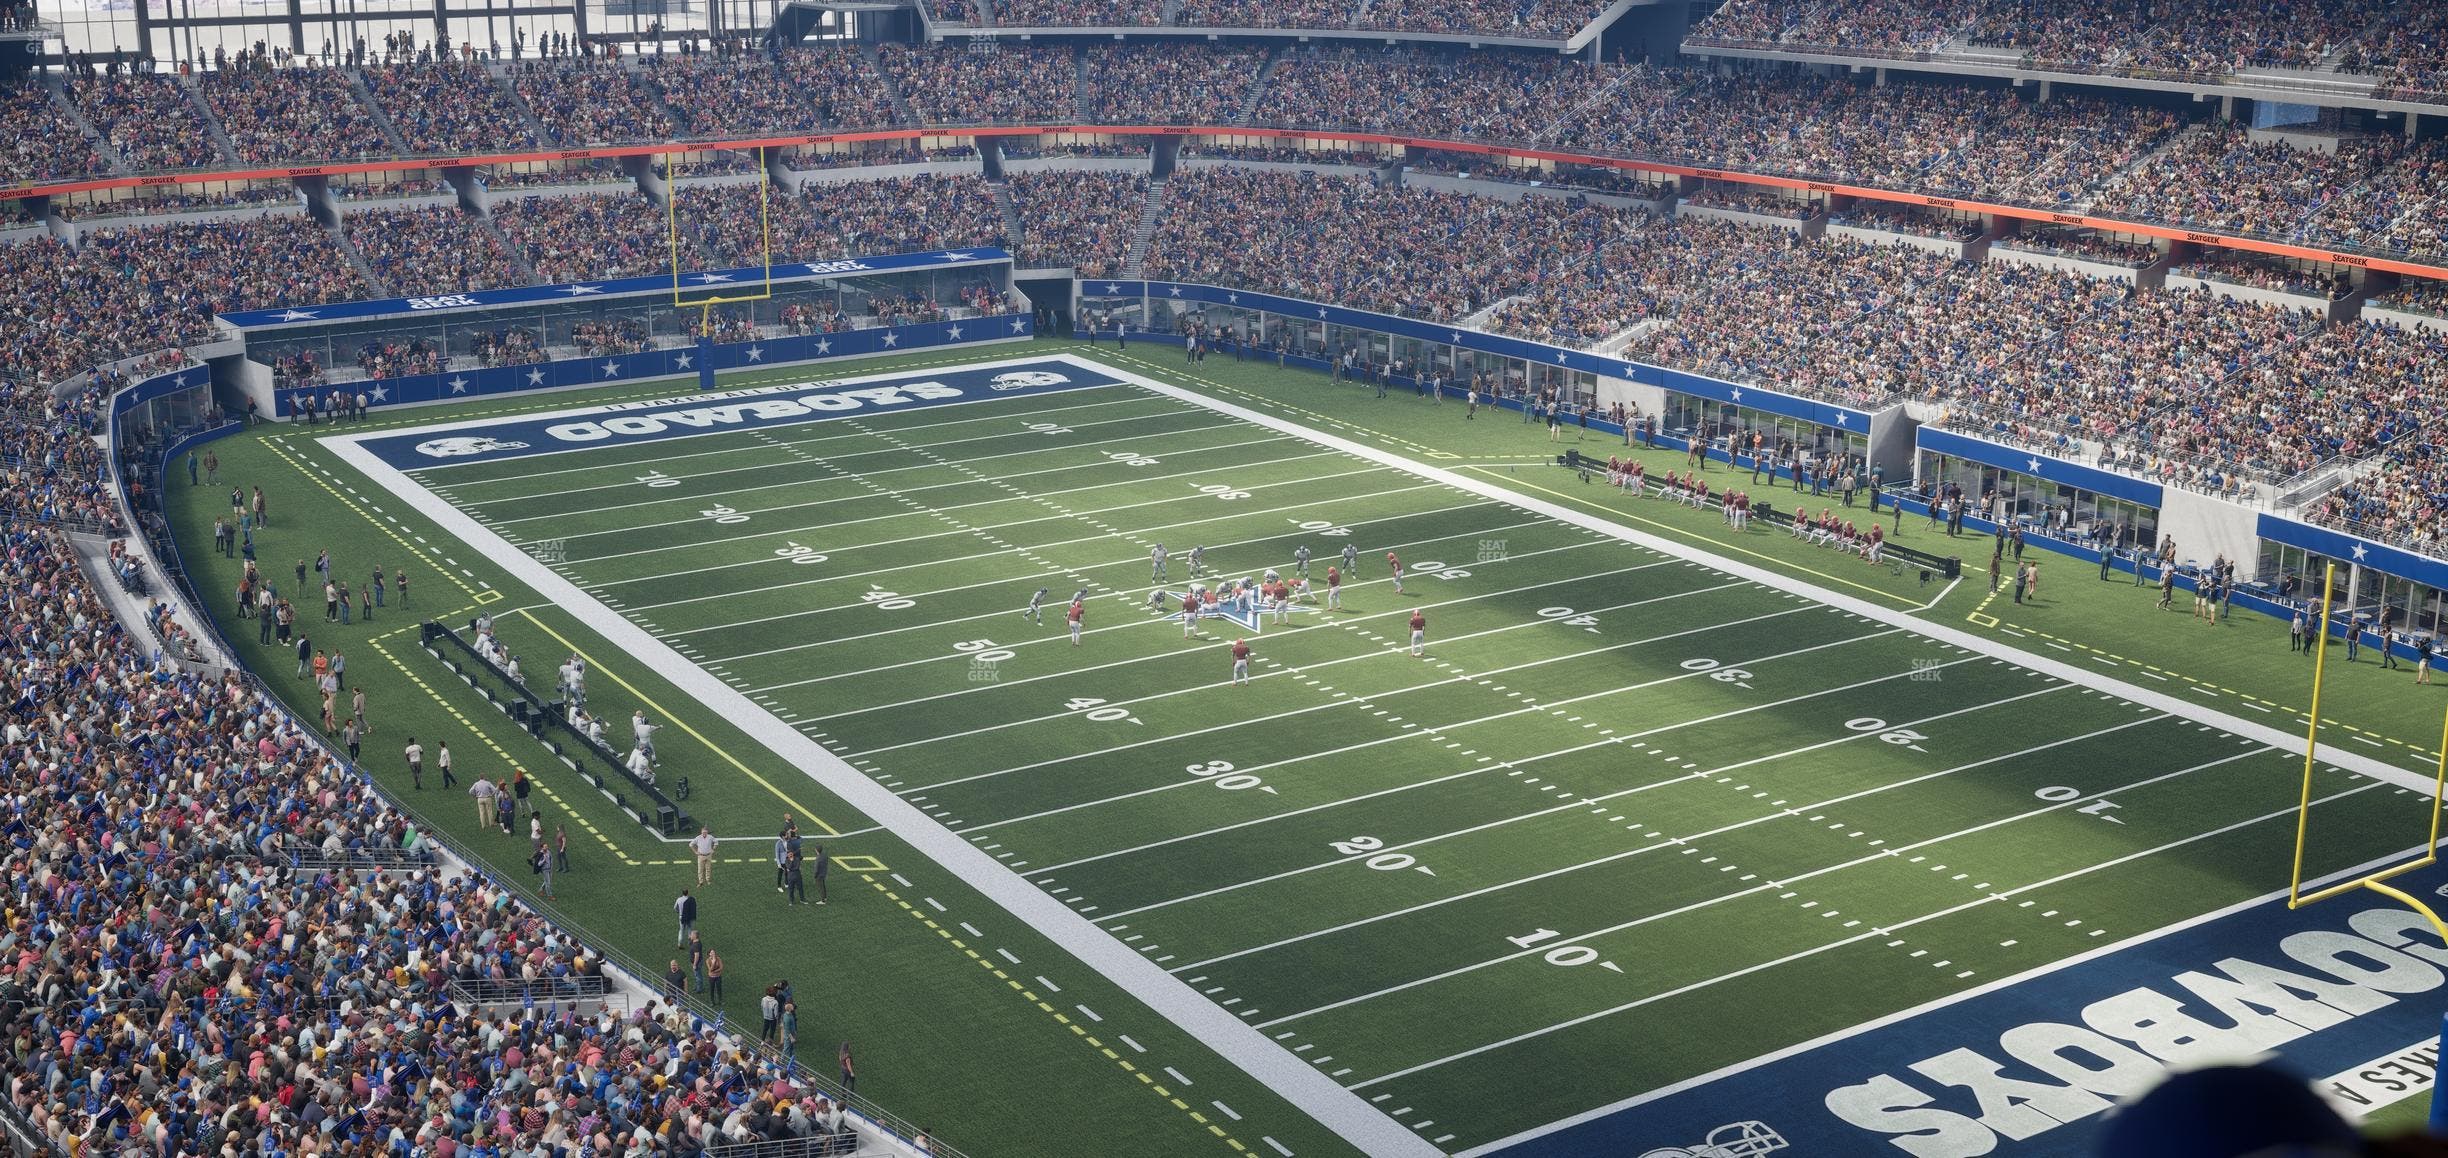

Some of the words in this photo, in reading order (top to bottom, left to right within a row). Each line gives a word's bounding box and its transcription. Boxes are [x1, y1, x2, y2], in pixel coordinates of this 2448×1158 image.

[920, 129, 949, 137] SEATGEEK
[1042, 126, 1070, 134] SEATGEEK
[1280, 130, 1306, 138] SEATGEEK
[807, 136, 834, 144] SEATGEEK
[687, 143, 715, 151] SEATGEEK
[1487, 146, 1511, 155] SEATGEEK
[561, 151, 591, 159] SEATGEEK
[428, 159, 460, 167] SEATGEEK
[1590, 157, 1614, 167] SEATGEEK
[288, 167, 322, 176] SEATGEEK
[1696, 169, 1722, 179] SEATGEEK
[141, 176, 176, 185] SEATGEEK
[0, 189, 33, 198] SEATGEEK
[1808, 183, 1835, 193] SEATGEEK
[1927, 197, 1955, 208] SEATGEEK
[2053, 214, 2084, 225] SEATGEEK
[2187, 232, 2220, 245] SEATGEEK
[805, 259, 857, 269] SEAT
[2332, 253, 2368, 267] SEATGEEK
[811, 264, 875, 274] GEEK
[406, 294, 467, 305] SEAT
[410, 299, 483, 310] GEEK
[638, 393, 715, 407] TAKES
[725, 388, 764, 398] ALL
[775, 384, 802, 392] OF
[812, 380, 842, 388] US
[545, 381, 964, 441] COWBOYS
[1028, 423, 1074, 435] 10
[1109, 452, 1160, 466] 20
[635, 473, 681, 488] 10
[1200, 484, 1251, 500] 30
[702, 507, 750, 524] 20
[1299, 520, 1352, 536] 40
[774, 546, 828, 564] 30
[1411, 561, 1472, 580] 50
[862, 591, 916, 610] 40
[1536, 607, 1599, 626] 40
[953, 638, 1015, 661] 50
[1680, 658, 1753, 682] 30
[1064, 697, 1130, 721] 40
[1844, 717, 1929, 745] 20
[1186, 760, 1262, 789] 30
[2034, 786, 2122, 815] 10
[1329, 836, 1416, 871] 20
[1506, 927, 1599, 966] 10
[1825, 908, 2448, 1158] COWBOYS
[2359, 1042, 2440, 1092] KES
